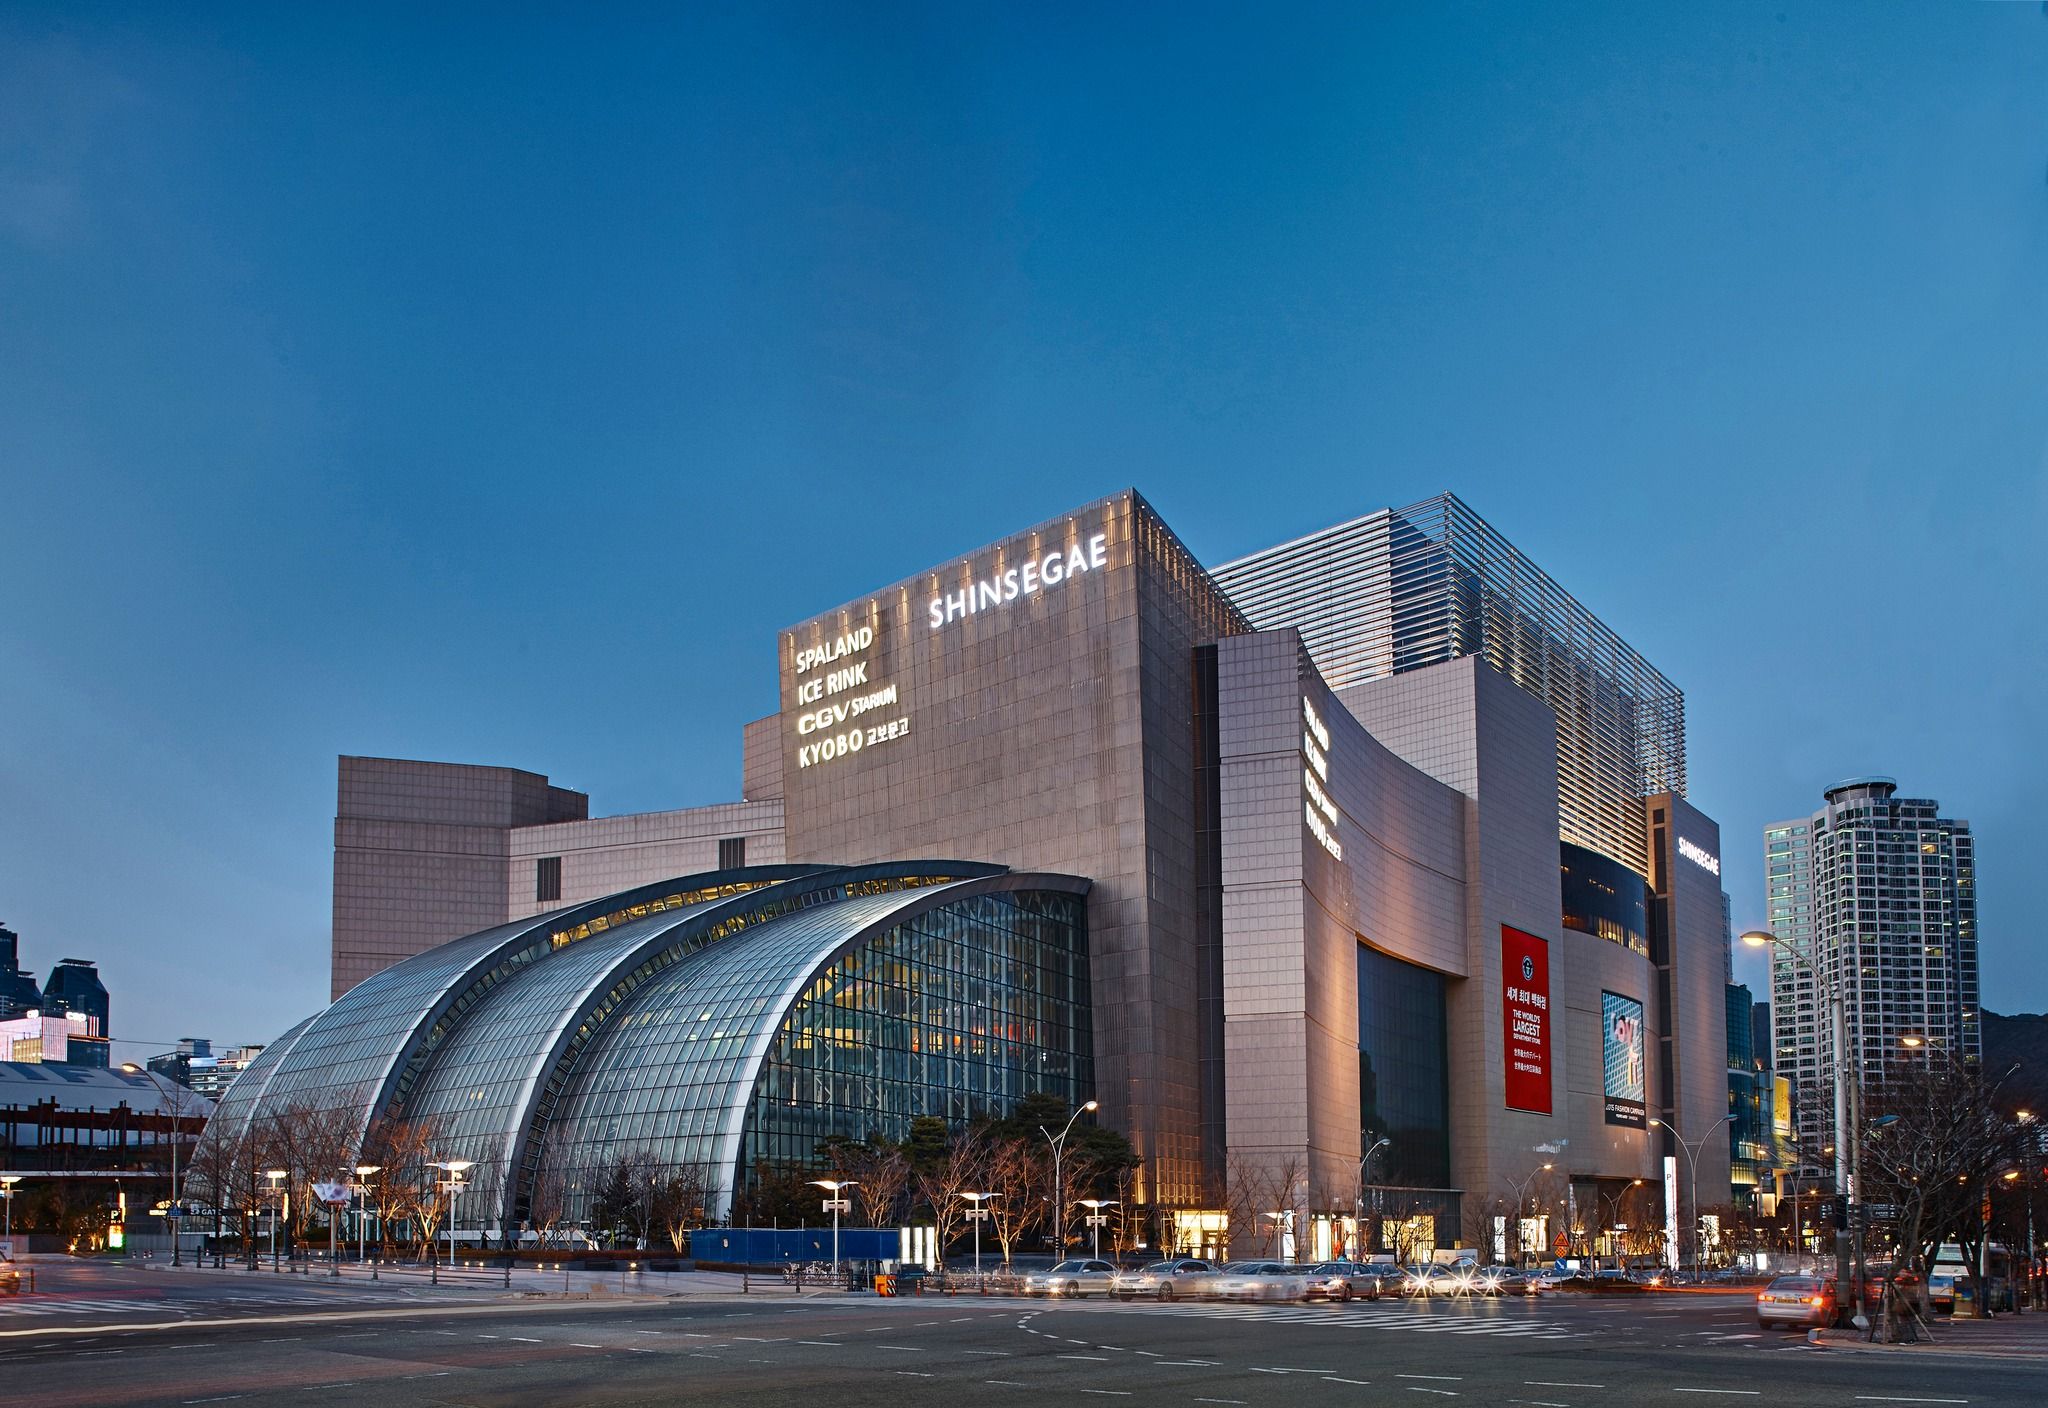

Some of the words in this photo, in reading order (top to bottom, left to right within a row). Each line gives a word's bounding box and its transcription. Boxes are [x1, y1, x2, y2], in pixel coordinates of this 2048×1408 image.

[929, 533, 1108, 629] SHINSEGAE
[796, 626, 873, 674] SPALAND
[798, 678, 824, 706] ICE
[827, 661, 868, 695] RINK
[798, 700, 851, 736] CGV
[850, 684, 898, 717] STARIUM
[799, 728, 864, 769] KYOBO
[866, 717, 910, 747] 교보문고
[1678, 836, 1719, 877] SHINSEGAE
[1507, 987, 1517, 1002] 세계
[1519, 990, 1530, 1005] 최대
[1531, 993, 1546, 1010] 백화점
[1513, 1009, 1521, 1018] THE
[1513, 1019, 1540, 1037] LARGEST
[1666, 1173, 1672, 1181] P
[111, 1210, 119, 1220] P
